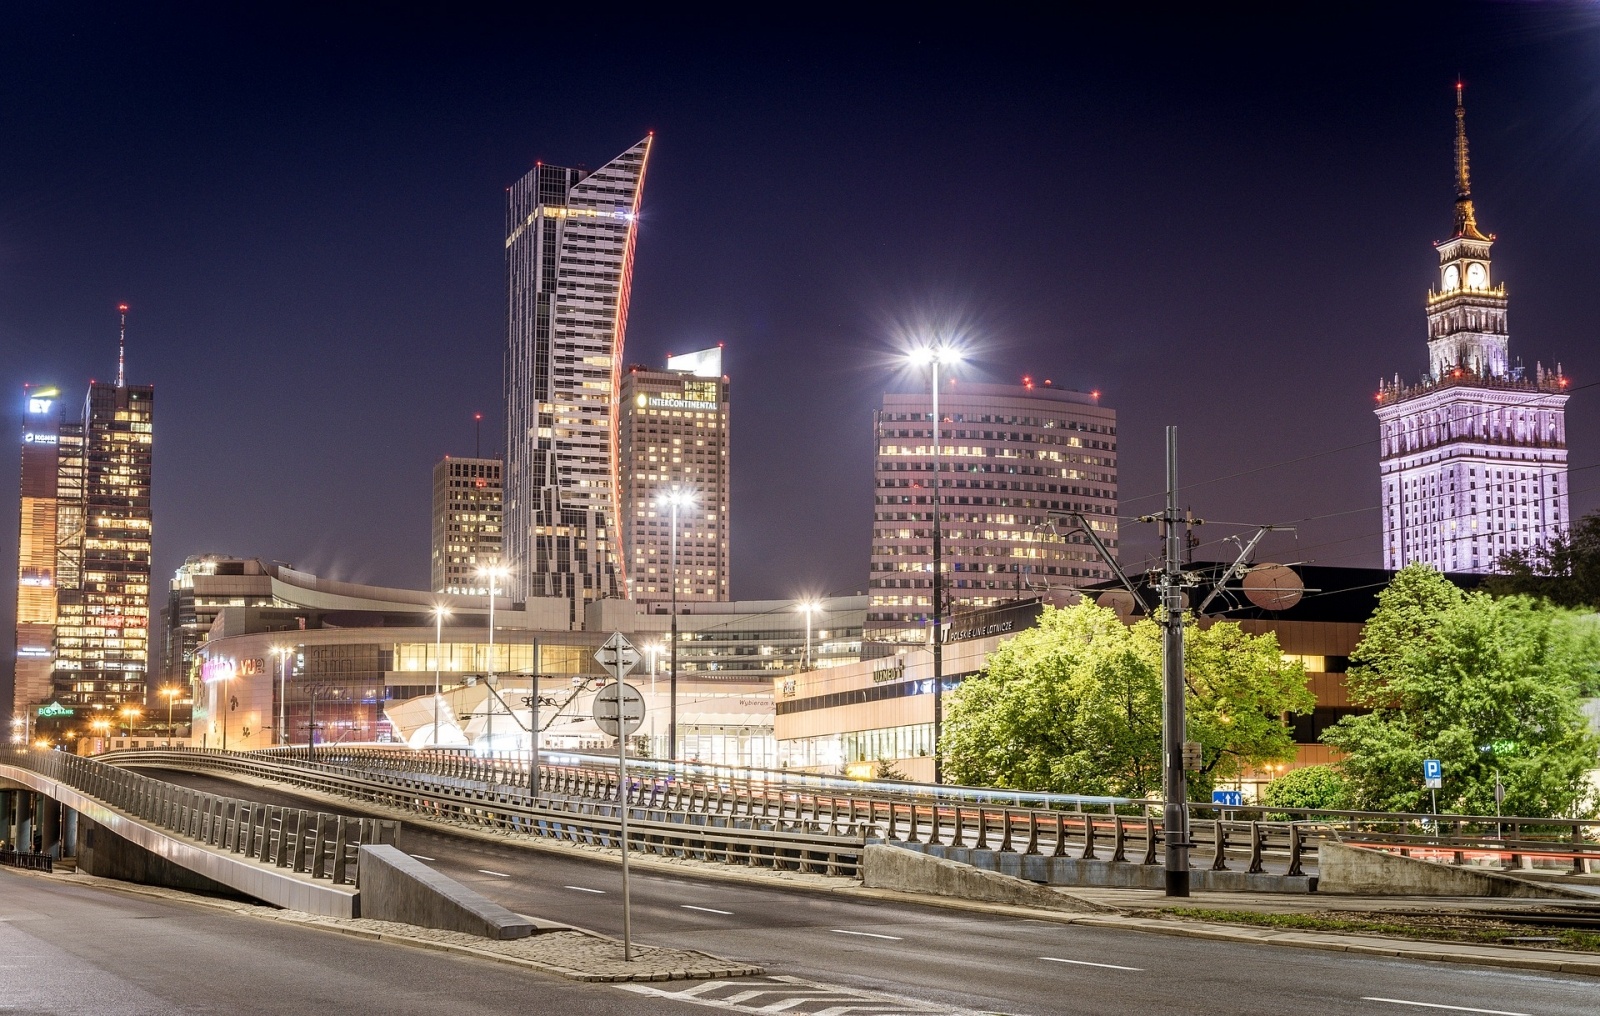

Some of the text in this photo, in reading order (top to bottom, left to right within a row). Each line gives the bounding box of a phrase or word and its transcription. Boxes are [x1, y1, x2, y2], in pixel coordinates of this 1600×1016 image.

[30, 399, 52, 413] EY
[951, 620, 1012, 641] POLSKIE LINIE LOTNICZE
[1428, 761, 1438, 777] P
